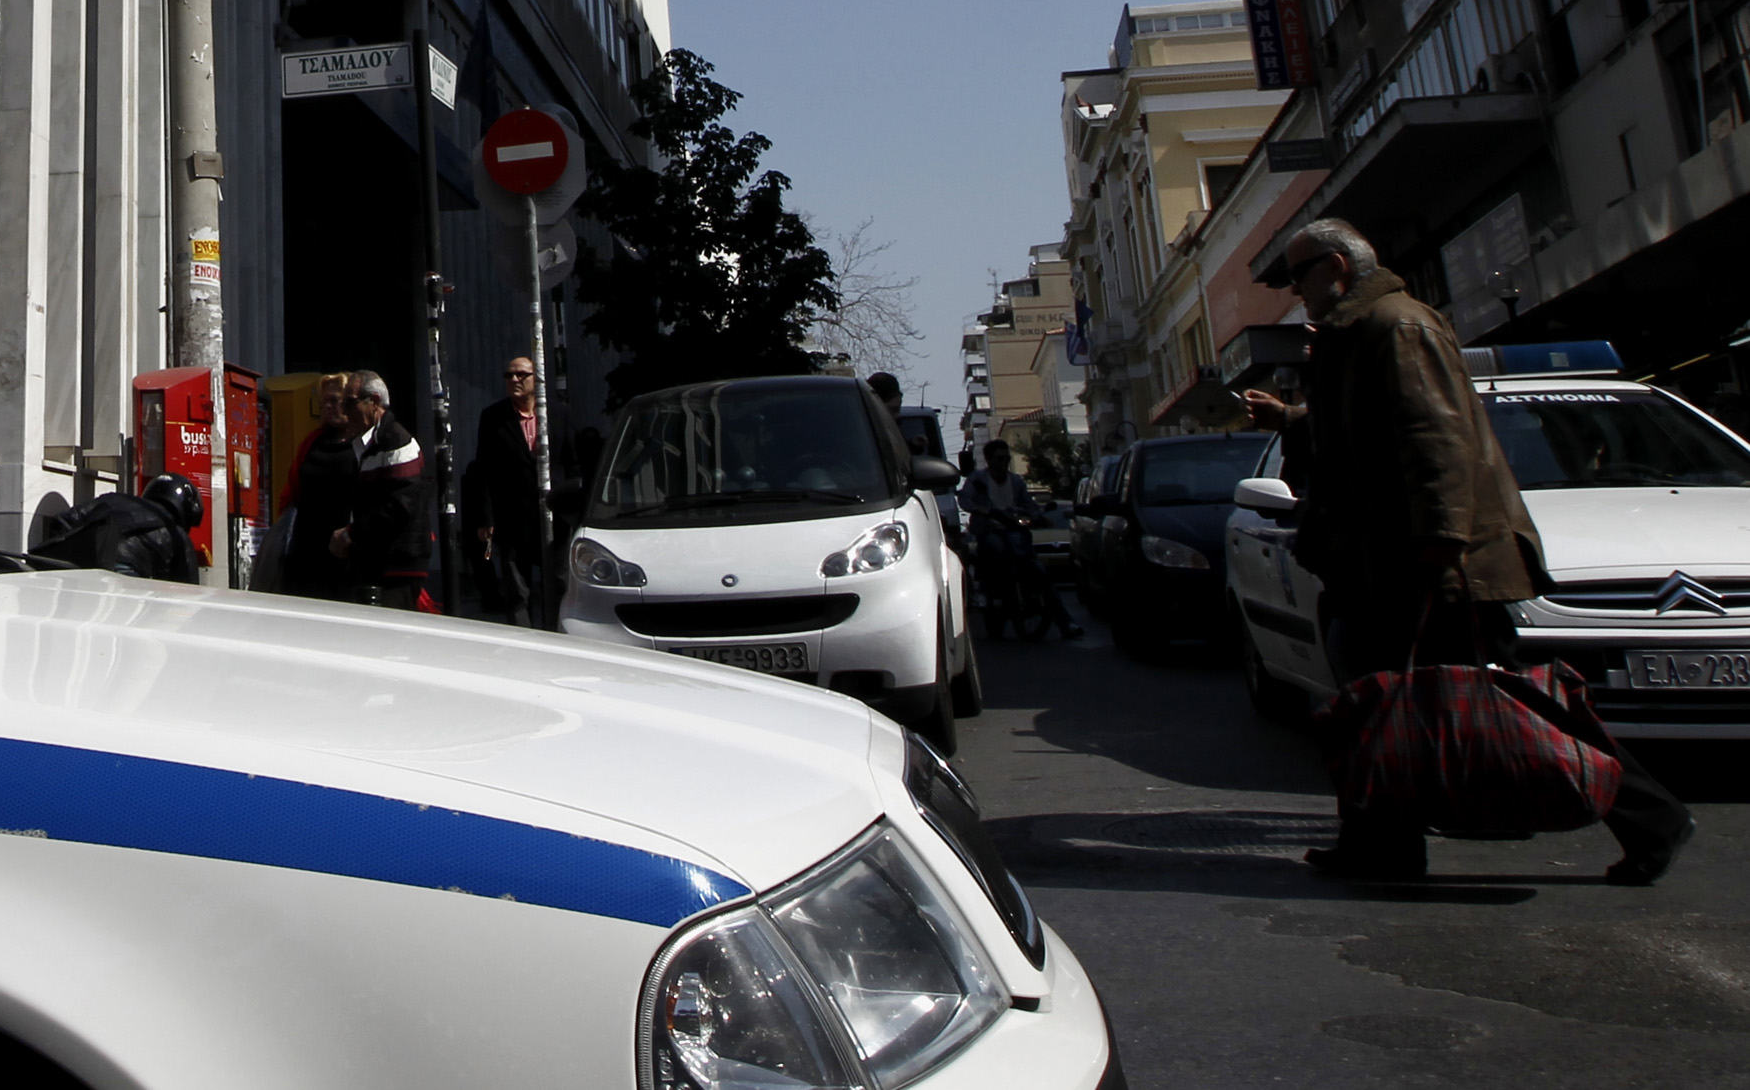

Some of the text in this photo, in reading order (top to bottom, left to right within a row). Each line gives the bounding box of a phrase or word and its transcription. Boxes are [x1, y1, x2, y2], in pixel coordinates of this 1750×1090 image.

[299, 50, 395, 74] ΤΣΑΜΑΔΟΥ
[327, 72, 367, 82] TSAMADOU
[1495, 393, 1621, 404] ΑΣΤΥΝΟΜΙΑ
[180, 425, 212, 446] busi
